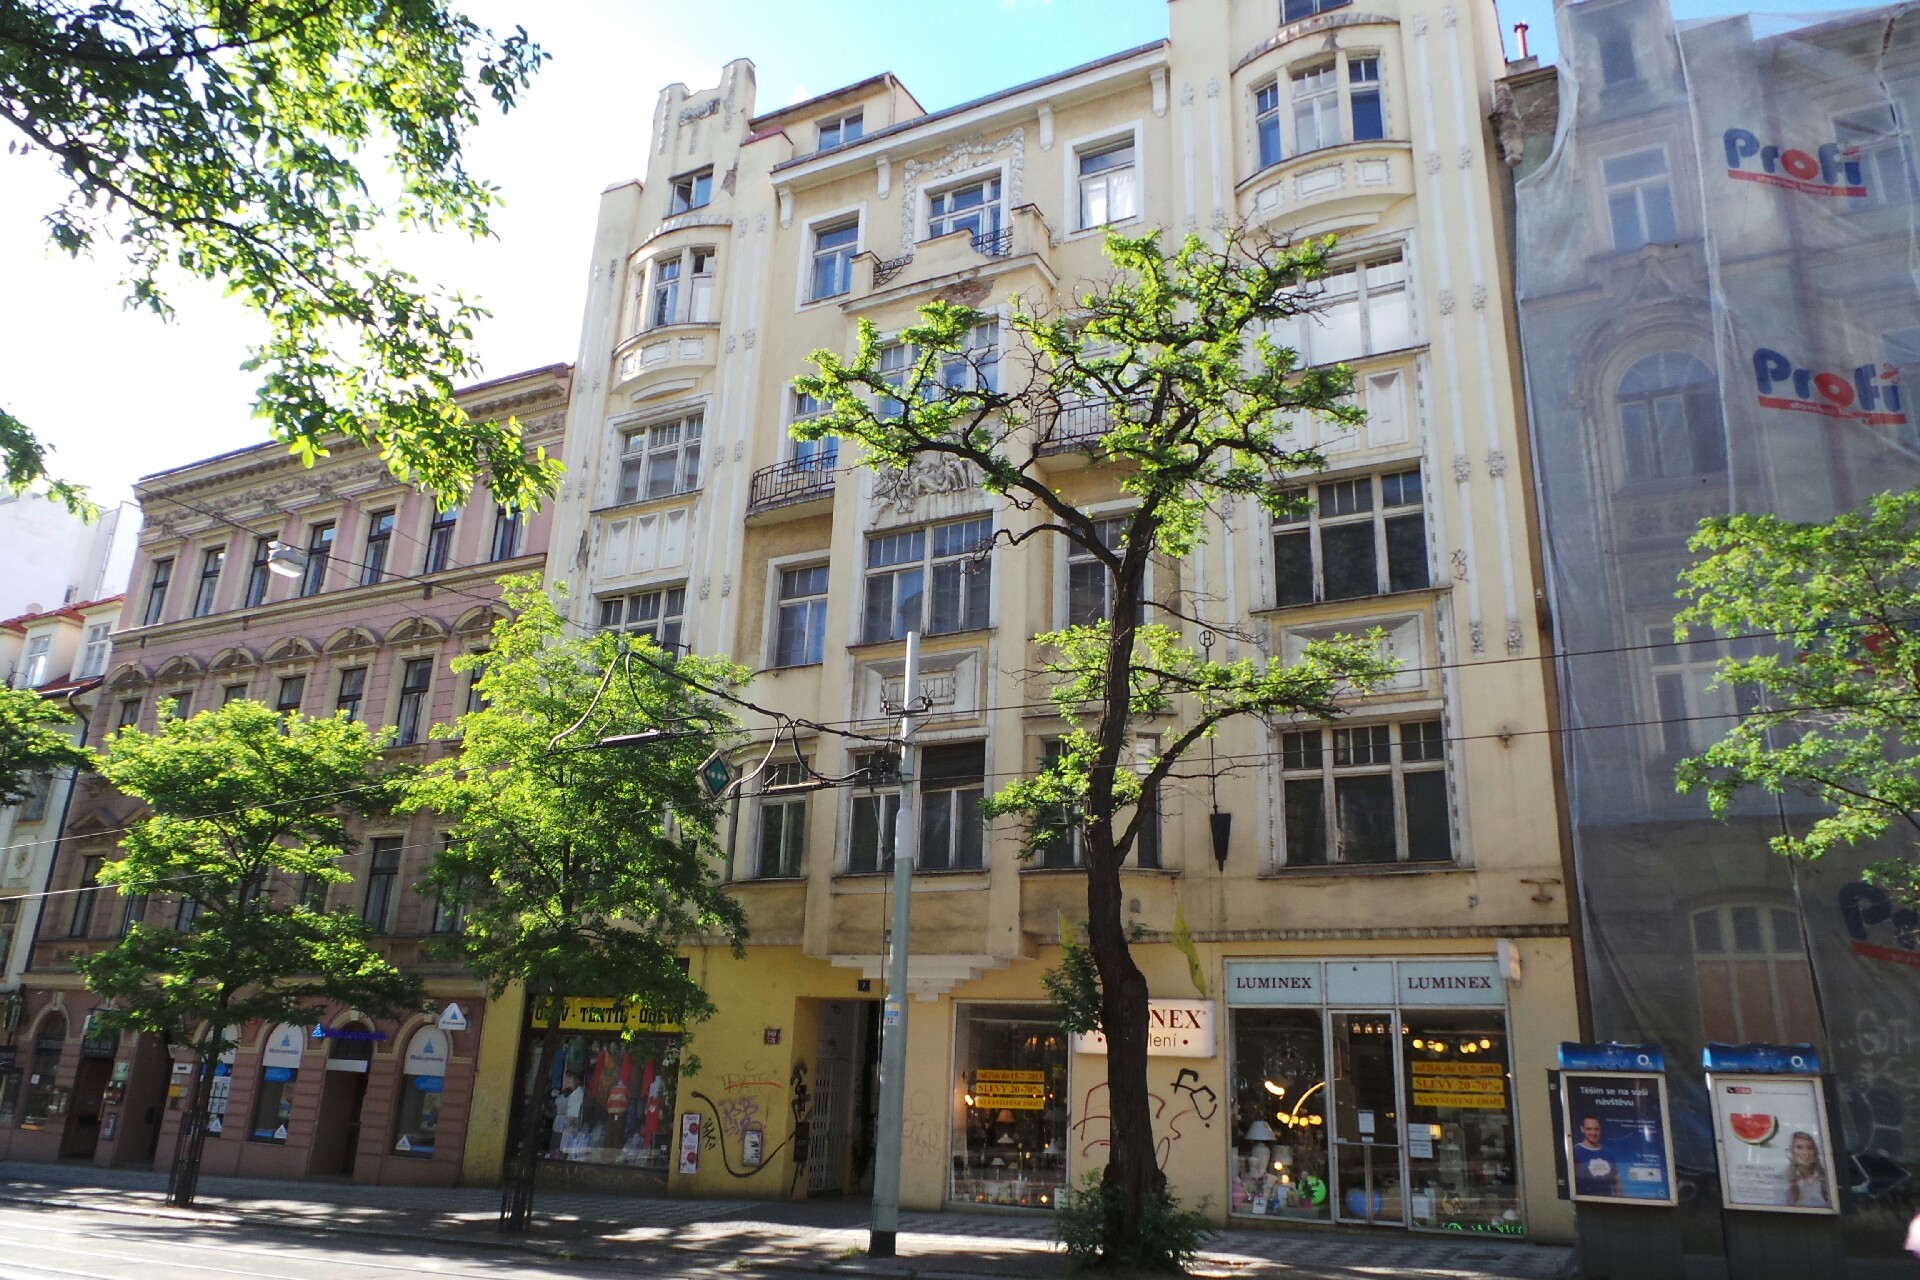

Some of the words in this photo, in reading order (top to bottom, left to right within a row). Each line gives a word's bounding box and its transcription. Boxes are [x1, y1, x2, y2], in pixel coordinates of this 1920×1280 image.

[1236, 976, 1313, 989] LUMINEX
[1407, 976, 1492, 989] LUMINEX
[978, 1083, 1006, 1093] SLEVY
[1416, 1078, 1453, 1090] SLEVY
[1606, 1088, 1616, 1096] se
[1617, 1088, 1629, 1096] na
